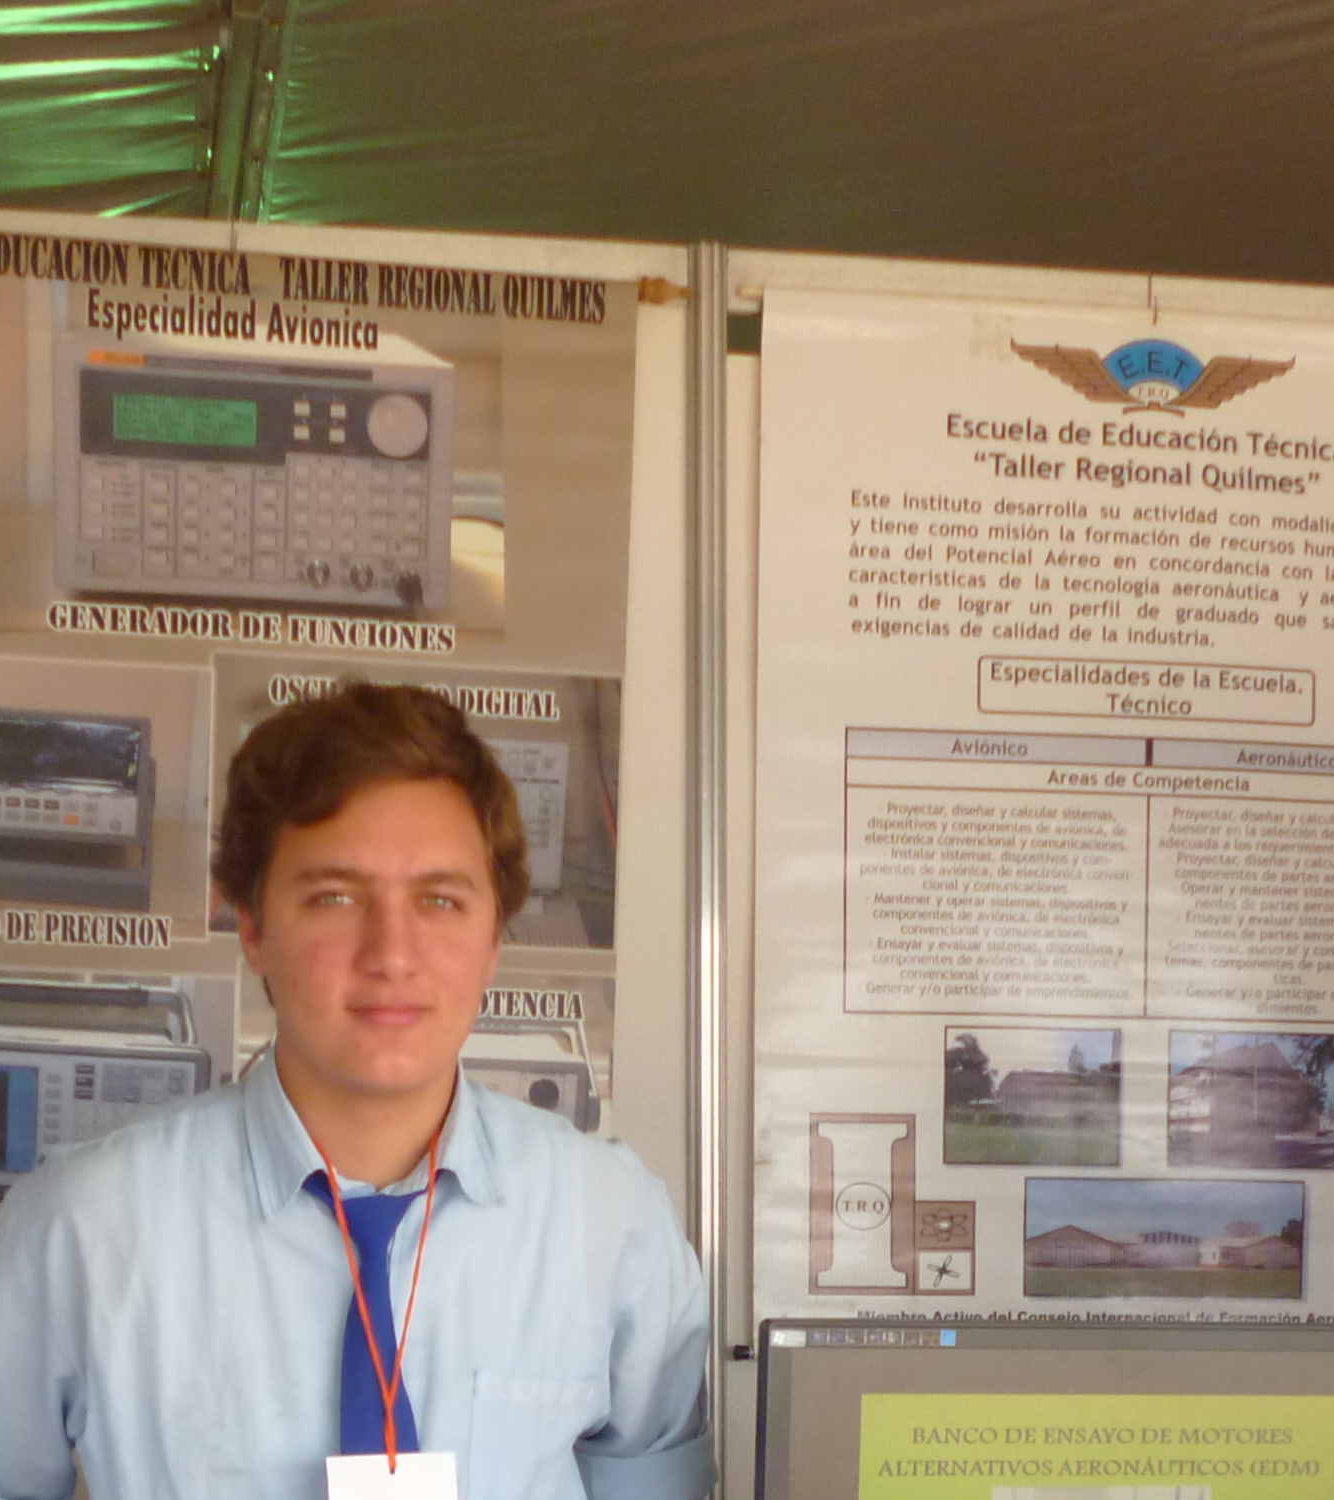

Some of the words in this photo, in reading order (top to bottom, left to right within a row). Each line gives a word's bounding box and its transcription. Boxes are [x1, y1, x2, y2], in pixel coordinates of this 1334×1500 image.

[137, 244, 255, 296] TECNICA
[279, 256, 369, 305] TALLER
[377, 263, 497, 315] REGIONAL
[502, 274, 606, 323] QUILMES
[87, 287, 256, 341] Especialidad
[267, 302, 379, 350] Avionica
[946, 412, 1048, 443] Escuela
[1058, 419, 1092, 445] de
[1101, 421, 1238, 453] Educación
[973, 451, 1065, 479] “Taller
[1076, 456, 1192, 488] Regional
[1201, 463, 1321, 494] Quilmes”
[850, 488, 891, 508] Este
[903, 492, 982, 514] Instituto
[993, 497, 1088, 519] desarrolla
[1100, 505, 1121, 520] su
[1132, 505, 1218, 524] actividad
[1228, 511, 1261, 528] con
[850, 518, 861, 537] y
[870, 516, 919, 536] tiene
[928, 522, 979, 538] como
[988, 522, 1050, 541] misión
[1059, 524, 1076, 542] la
[1085, 525, 1180, 547] formación
[1188, 531, 1212, 549] de
[1220, 536, 1296, 555] recursos
[848, 540, 891, 560] área
[903, 542, 933, 561] del
[946, 544, 1033, 565] Potencial
[1044, 549, 1101, 568] Aéreo
[1113, 554, 1137, 570] en
[1148, 556, 1270, 577] concordancia
[1281, 564, 1314, 581] con
[848, 568, 987, 588] características
[998, 572, 1022, 590] de
[1034, 573, 1051, 590] la
[1062, 575, 1160, 598] tecnología
[1172, 582, 1280, 602] aeronáutica
[1298, 590, 1309, 608] y
[48, 602, 231, 639] GENERADOR
[240, 612, 280, 643] DE
[288, 615, 455, 653] FUNCIONES
[851, 617, 951, 638] exigencias
[959, 619, 983, 638] de
[991, 621, 1060, 641] calidad
[1068, 623, 1092, 642] de
[1101, 624, 1118, 643] la
[1127, 626, 1215, 647] industria.
[990, 661, 1151, 695] Especialidades
[1158, 666, 1186, 689] de
[1193, 667, 1211, 689] la
[1218, 669, 1308, 694] Escuela.
[457, 685, 560, 721] DIGITAL
[1103, 692, 1197, 721] Técnico
[951, 737, 1029, 761] Aviónico
[1047, 768, 1098, 787] Areas
[1104, 769, 1127, 788] de
[1132, 770, 1251, 794] Competencia
[6, 909, 37, 942] DE
[42, 912, 172, 948] PRECISION
[912, 1427, 999, 1445] BANCO
[1004, 1426, 1037, 1444] DE
[1043, 1426, 1136, 1444] ENSAYO
[1140, 1426, 1172, 1444] DE
[1178, 1426, 1293, 1445] MOTORES
[877, 1458, 1053, 1477] ALTERNATIVOS
[1057, 1456, 1244, 1477] AERONÁUTICOS
[1249, 1459, 1320, 1477] (EDM)
